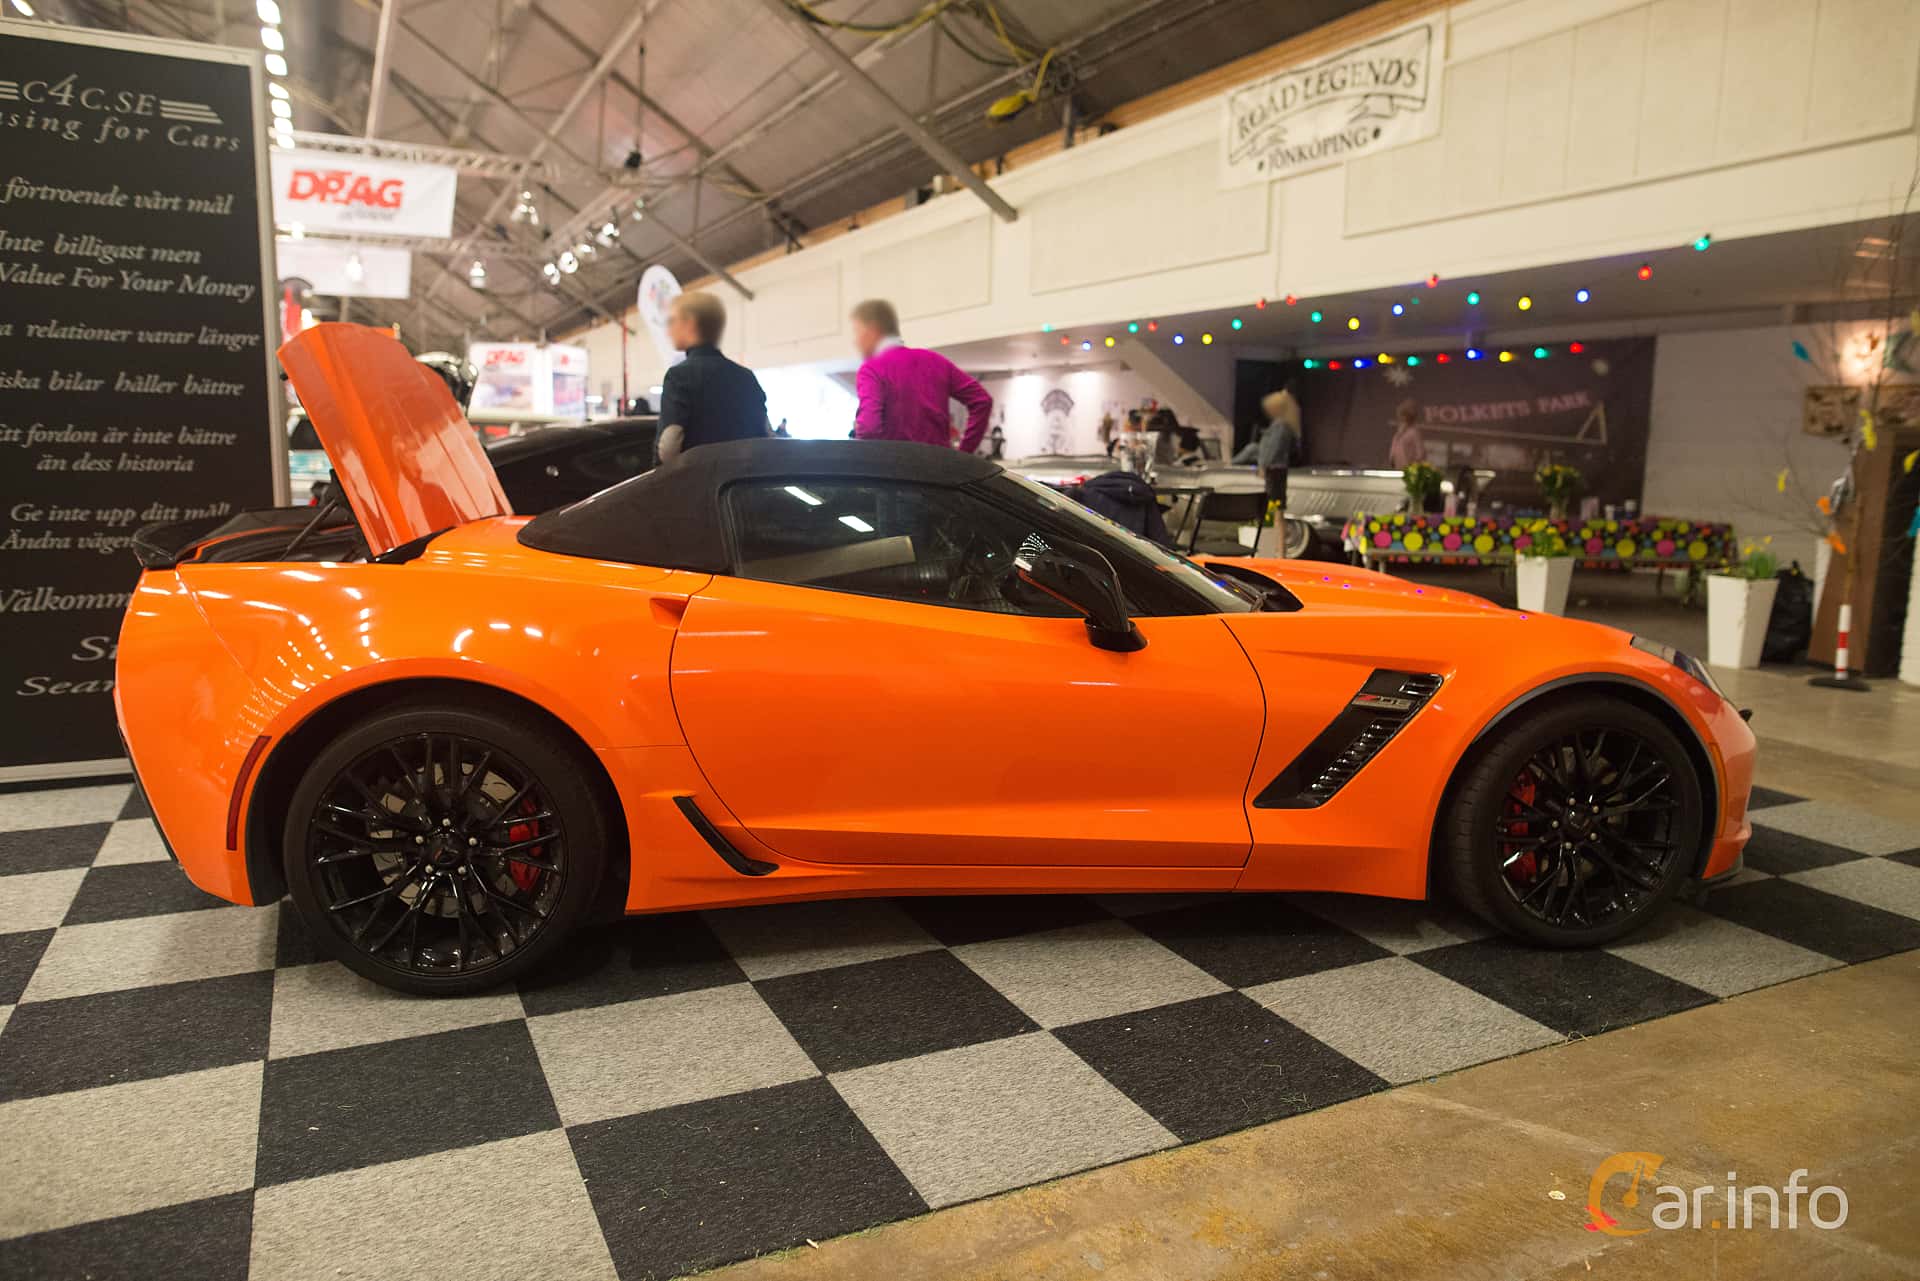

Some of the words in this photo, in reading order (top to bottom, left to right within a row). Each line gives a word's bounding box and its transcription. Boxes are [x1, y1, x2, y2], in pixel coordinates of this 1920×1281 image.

[22, 73, 156, 116] C4C.SE
[1237, 86, 1297, 139] ROAD
[1302, 59, 1419, 101] LEGENDS
[0, 109, 83, 141] sing
[94, 116, 150, 143] for
[167, 124, 240, 151] Cars
[1268, 127, 1369, 172] JÖNKÖPING
[0, 176, 128, 208] förtroende
[134, 190, 181, 211] vårt
[187, 194, 234, 215] mål
[287, 169, 405, 209] DRAG
[0, 230, 45, 253] Inte
[54, 232, 145, 265] billigast
[151, 246, 201, 264] men
[0, 262, 65, 286] Value
[71, 266, 115, 290] For
[119, 270, 175, 292] Your
[178, 274, 255, 303] Money
[26, 320, 131, 344] relationer
[198, 326, 261, 351] längre
[48, 370, 104, 392] bilar
[114, 371, 180, 394] håller
[183, 374, 245, 397] bättre
[21, 422, 97, 449] fordon
[103, 427, 128, 445] är
[132, 426, 170, 445] inte
[177, 425, 238, 446] bättre
[36, 454, 67, 472] än
[71, 452, 112, 472] dess
[116, 452, 195, 473] historia
[11, 503, 43, 522] Ge
[48, 505, 91, 522] inte
[95, 507, 136, 528] upp
[140, 502, 178, 521] ditt
[0, 529, 71, 550] Ändra
